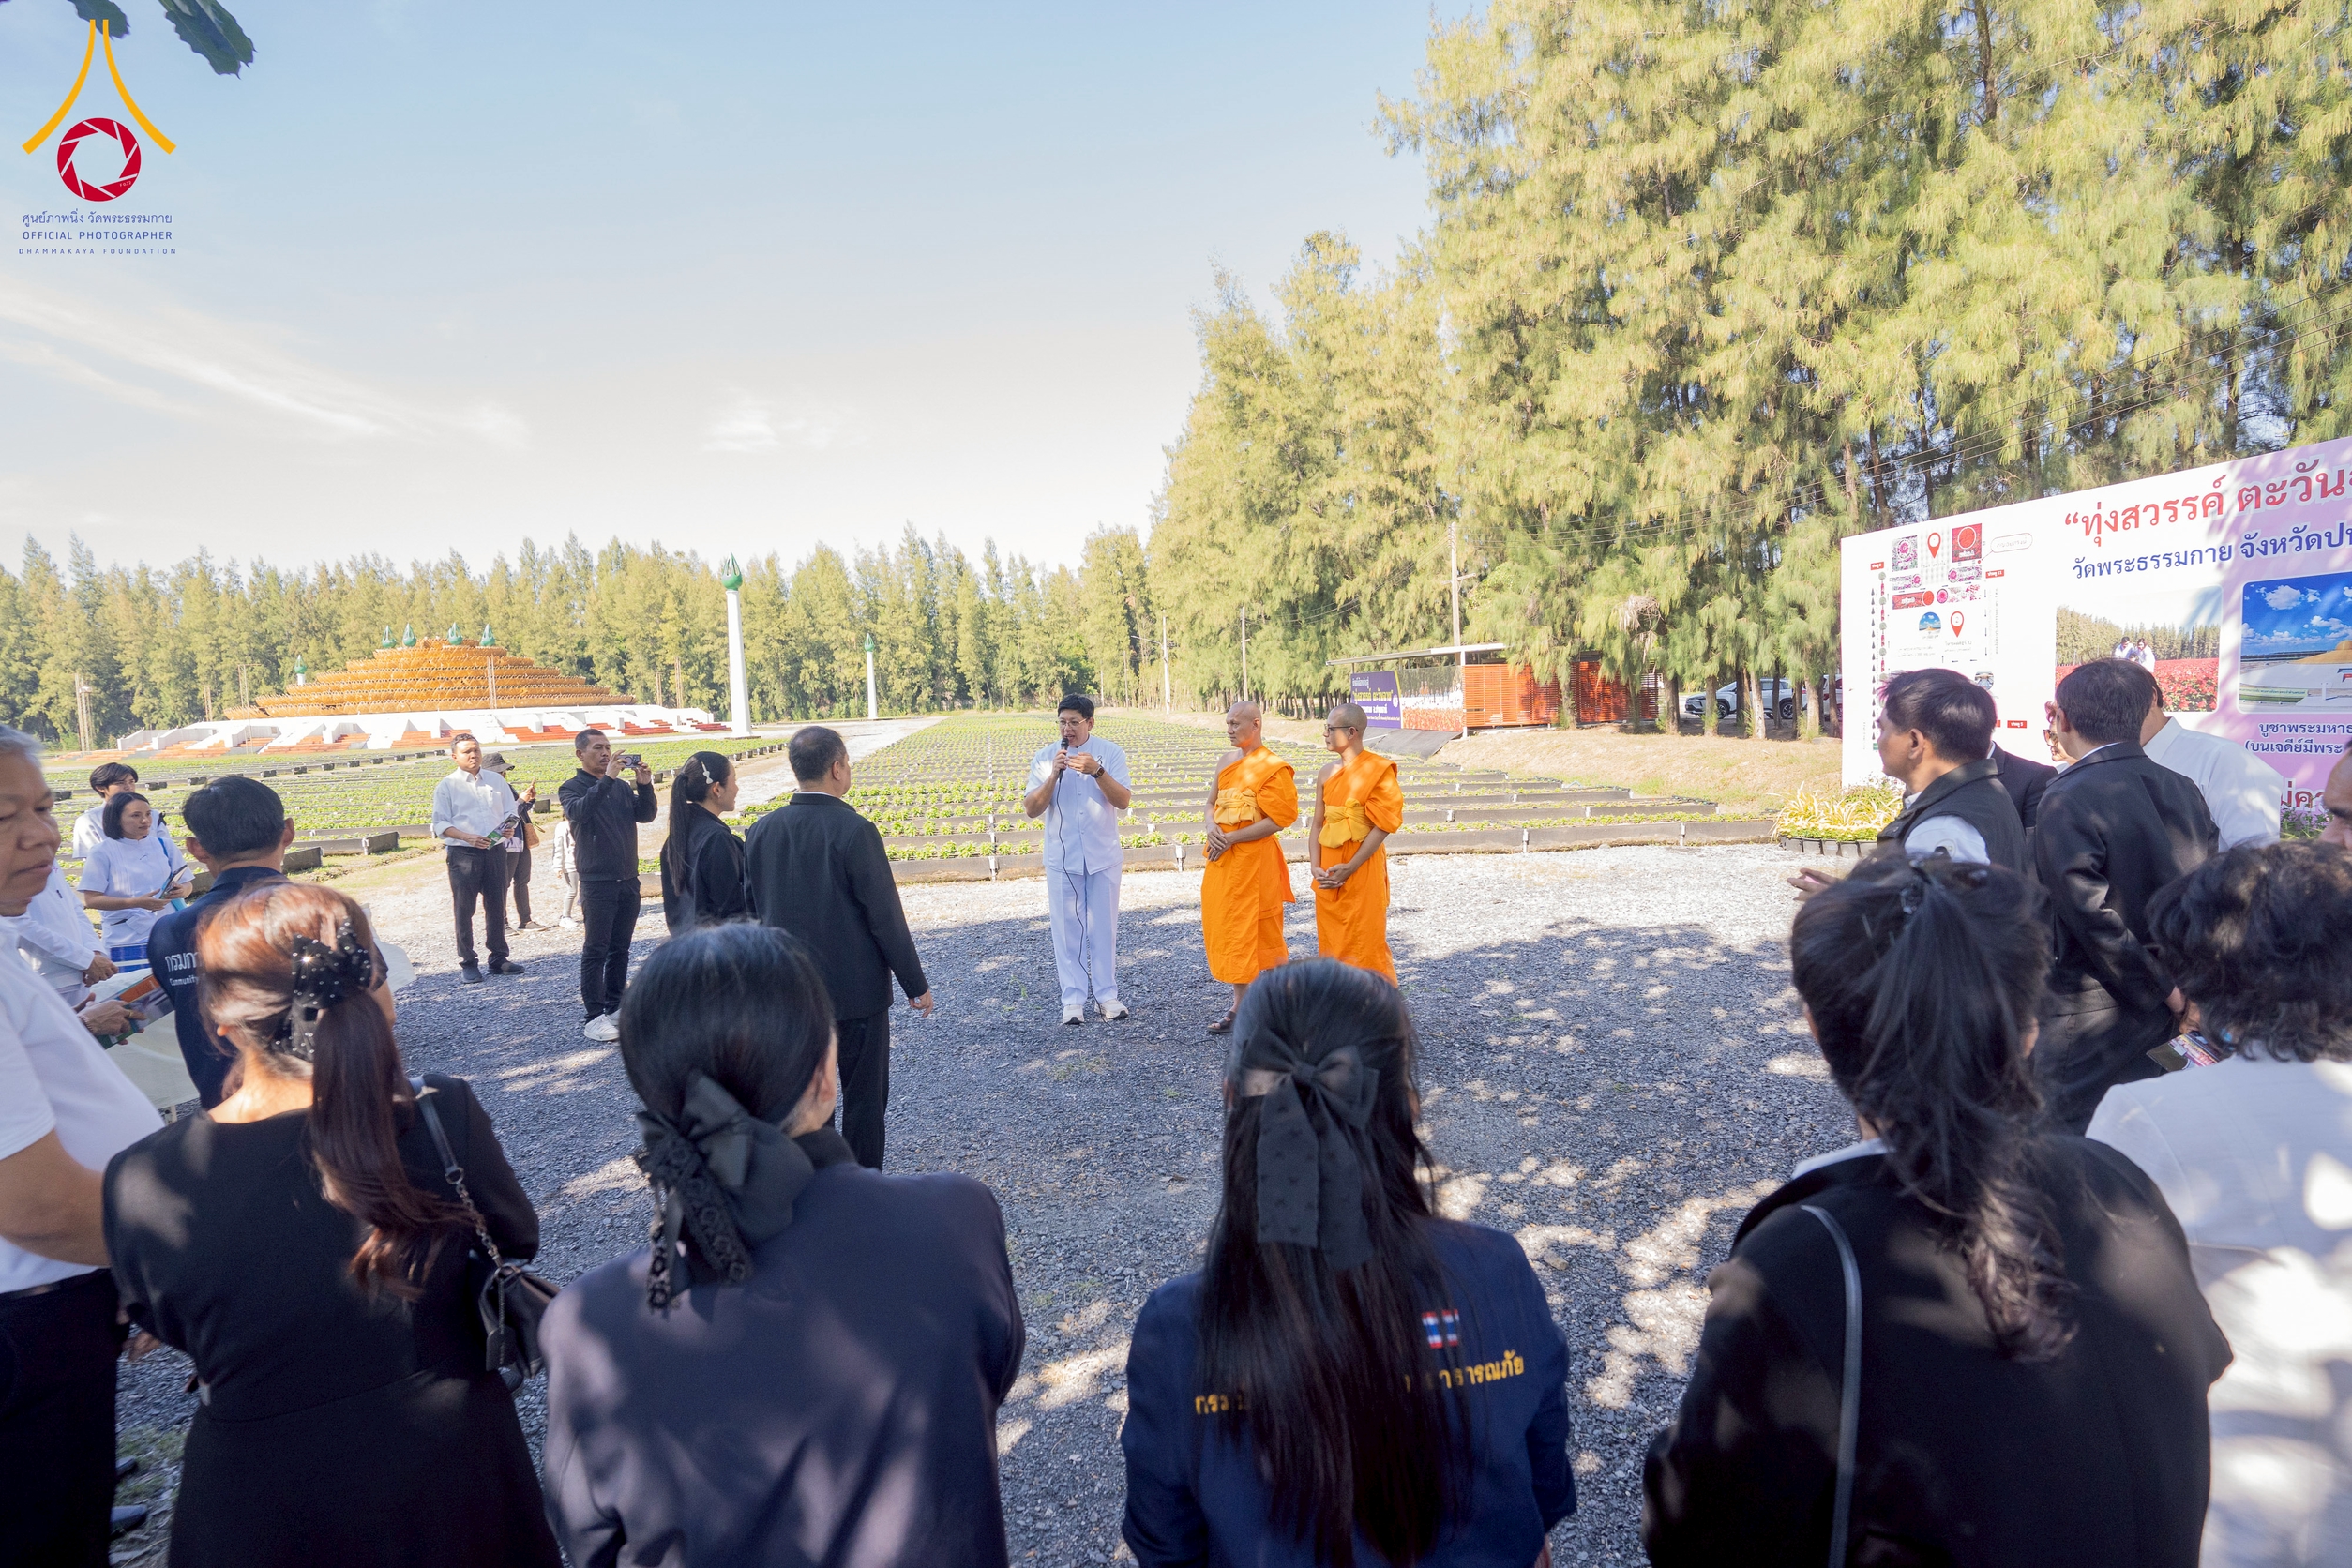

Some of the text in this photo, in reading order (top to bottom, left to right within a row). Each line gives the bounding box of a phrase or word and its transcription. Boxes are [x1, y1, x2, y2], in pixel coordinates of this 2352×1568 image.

[2065, 459, 2352, 547] “ทุ่งสวรรค์ ตะวัน
[2073, 544, 2232, 579] วัดพระธรรมกาย
